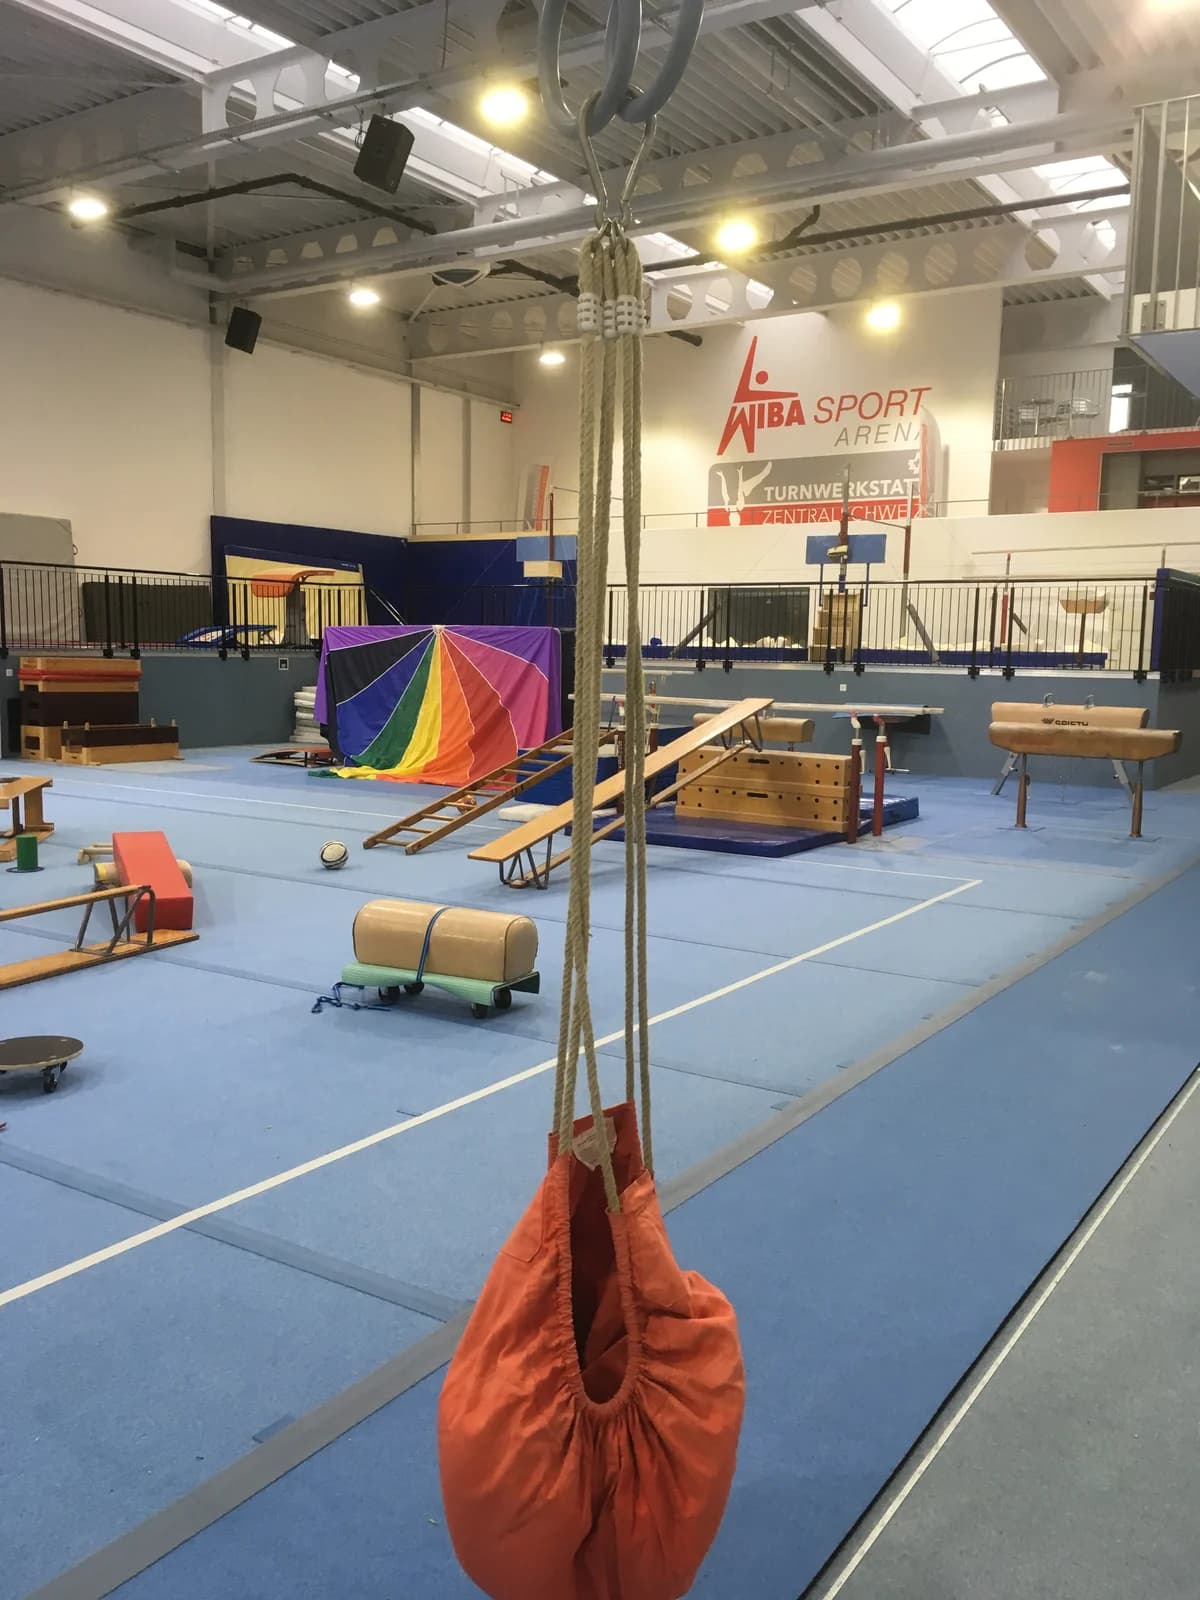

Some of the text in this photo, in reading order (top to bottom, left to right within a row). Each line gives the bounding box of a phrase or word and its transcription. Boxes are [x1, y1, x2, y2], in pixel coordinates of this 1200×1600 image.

[717, 387, 932, 455] WIBA SPORT
[764, 477, 920, 501] TURNWERKSTAT
